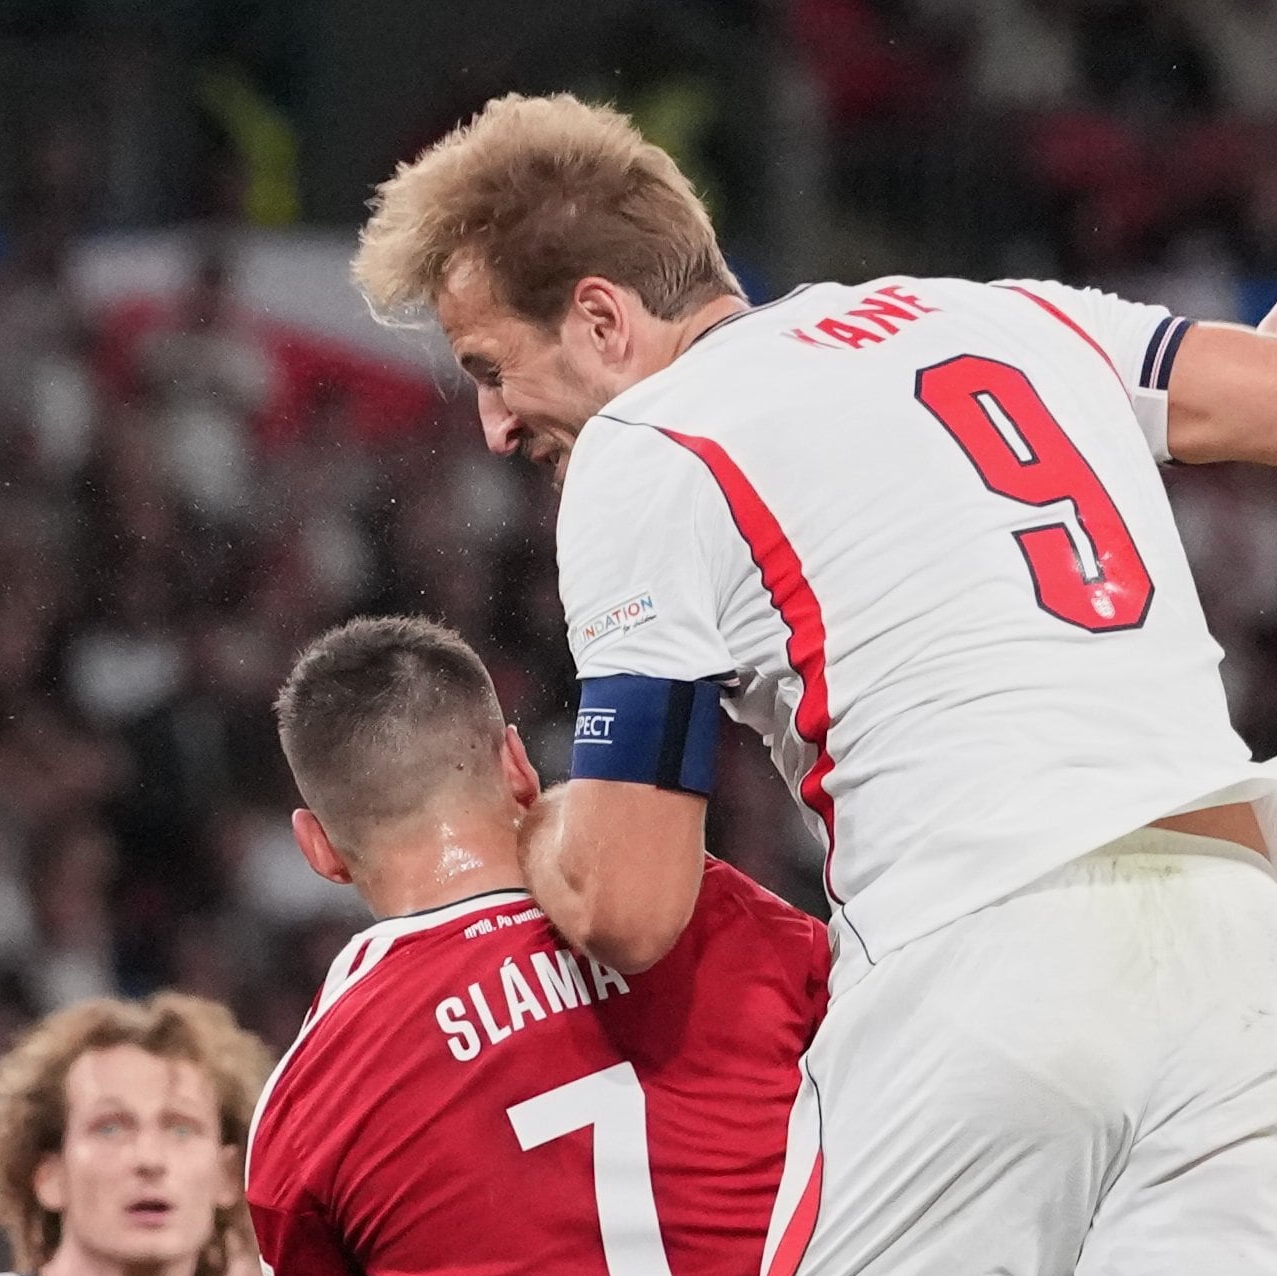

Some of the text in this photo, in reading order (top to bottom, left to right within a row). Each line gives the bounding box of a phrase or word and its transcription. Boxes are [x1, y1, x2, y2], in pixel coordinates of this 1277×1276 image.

[914, 353, 1155, 633] 9
[575, 715, 615, 737] PECT
[435, 949, 630, 1063] SLÁMA
